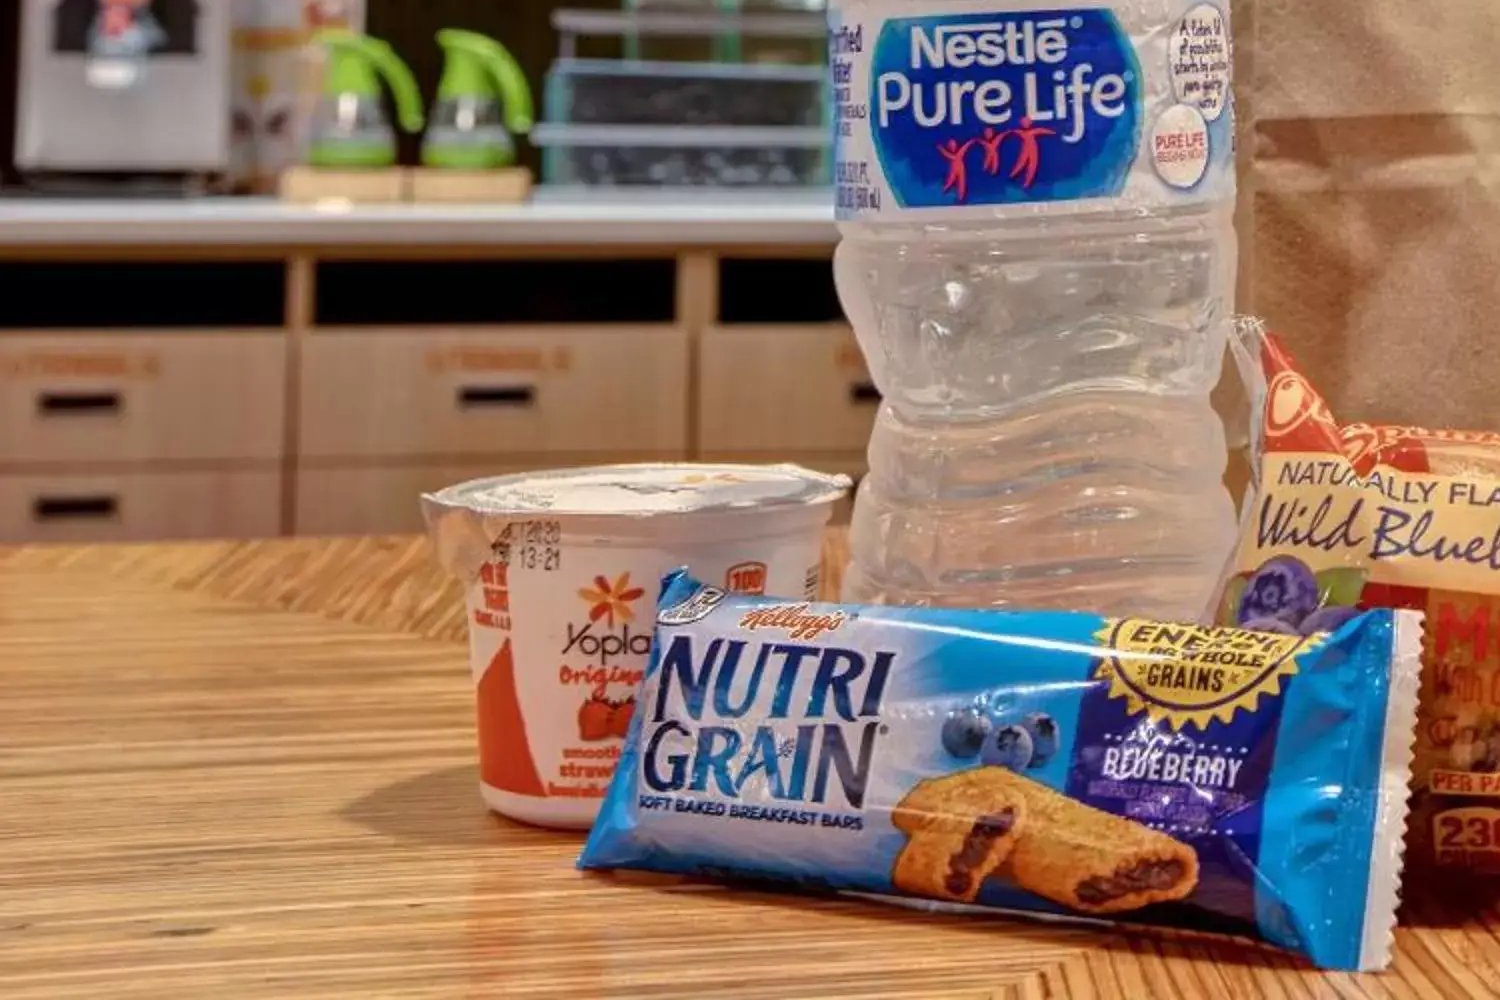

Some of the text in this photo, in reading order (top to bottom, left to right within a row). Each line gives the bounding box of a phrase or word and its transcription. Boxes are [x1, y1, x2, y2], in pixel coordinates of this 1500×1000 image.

[877, 63, 1126, 143] Pure Life
[1156, 132, 1204, 150] PURE LIFE
[1277, 461, 1438, 504] NATUALLY
[1257, 494, 1367, 550] Wild
[738, 602, 847, 640] Kellogg's
[562, 623, 651, 665] Yopla
[560, 664, 645, 698] Origina
[652, 635, 897, 722] NUTRI
[1147, 663, 1226, 693] GRAINS
[560, 761, 616, 778] straw
[643, 720, 879, 809] GRAIN
[1103, 747, 1243, 789] BLUEBERRY
[1433, 771, 1473, 792] PER
[638, 795, 866, 831] SOFT BAKED BREAKFAST BARS
